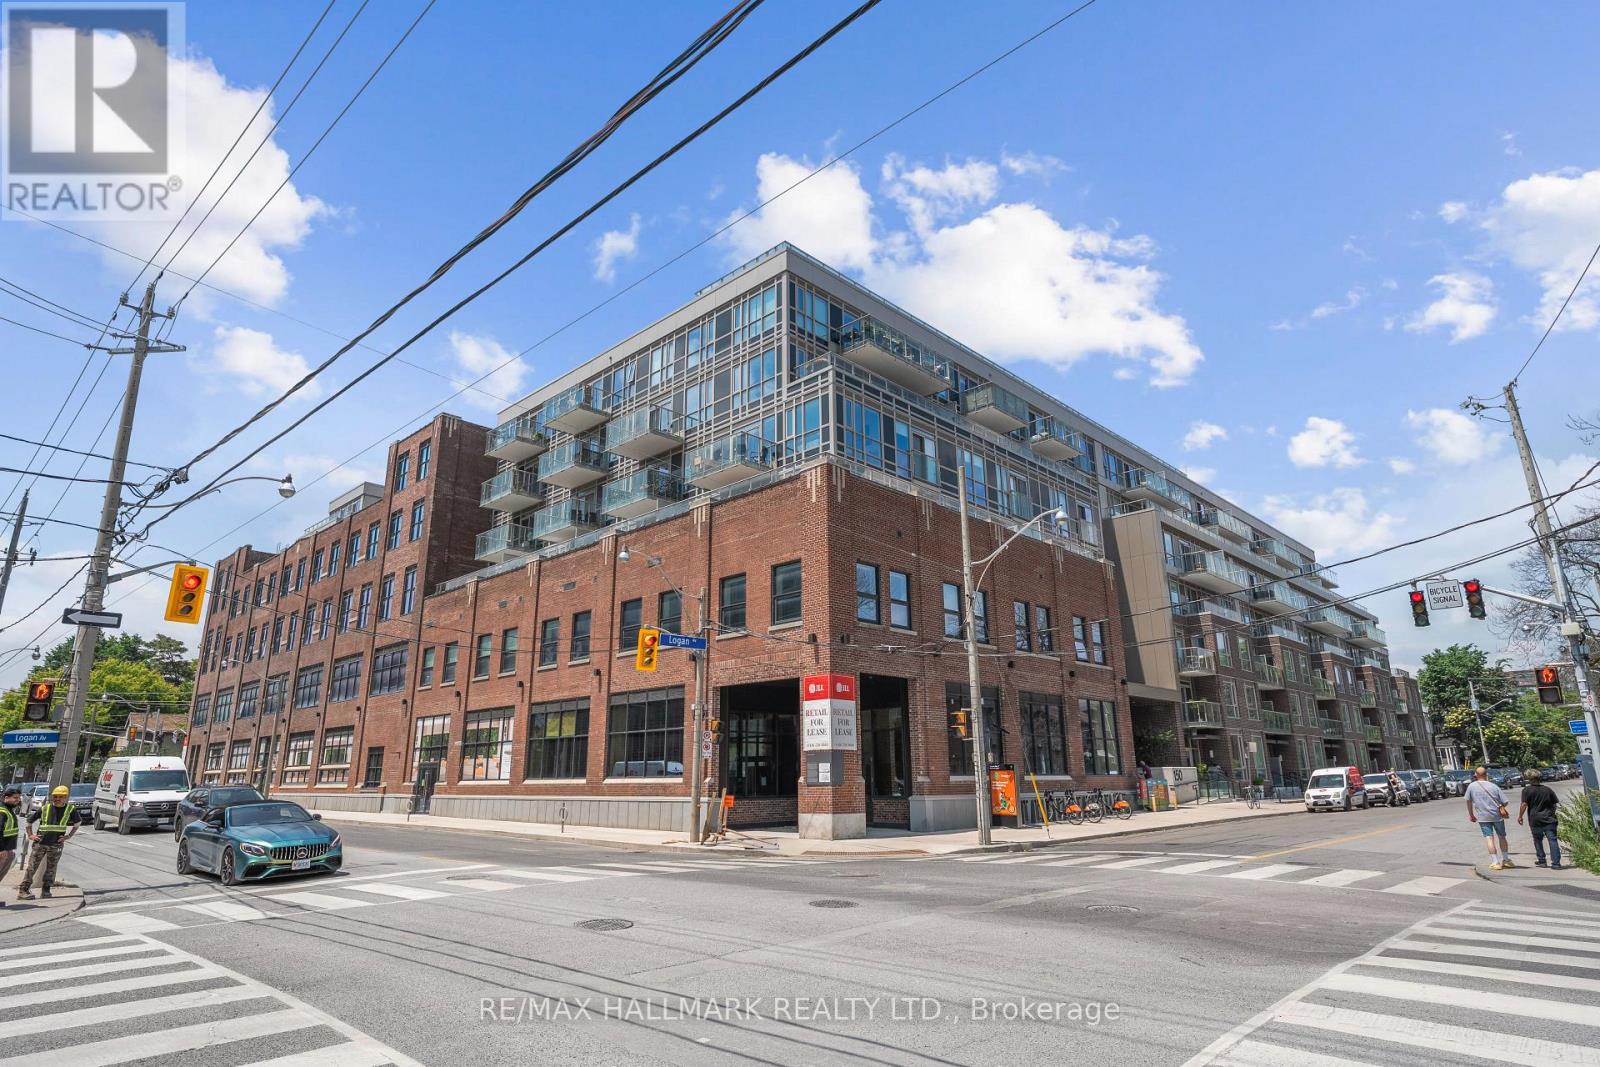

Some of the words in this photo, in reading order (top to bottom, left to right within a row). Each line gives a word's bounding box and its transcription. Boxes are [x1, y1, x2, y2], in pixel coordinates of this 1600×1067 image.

[1430, 585, 1458, 596] BICYCLE
[1433, 594, 1458, 604] SIGNAL
[668, 635, 690, 647] Logan
[806, 708, 828, 717] RETAIL
[833, 708, 854, 717] RETAIL
[810, 718, 824, 727] FOR
[837, 718, 850, 727] FOR
[807, 727, 828, 737] LEASE
[834, 727, 853, 737] LEASE
[15, 734, 38, 743] Logan
[1173, 769, 1183, 782] 150
